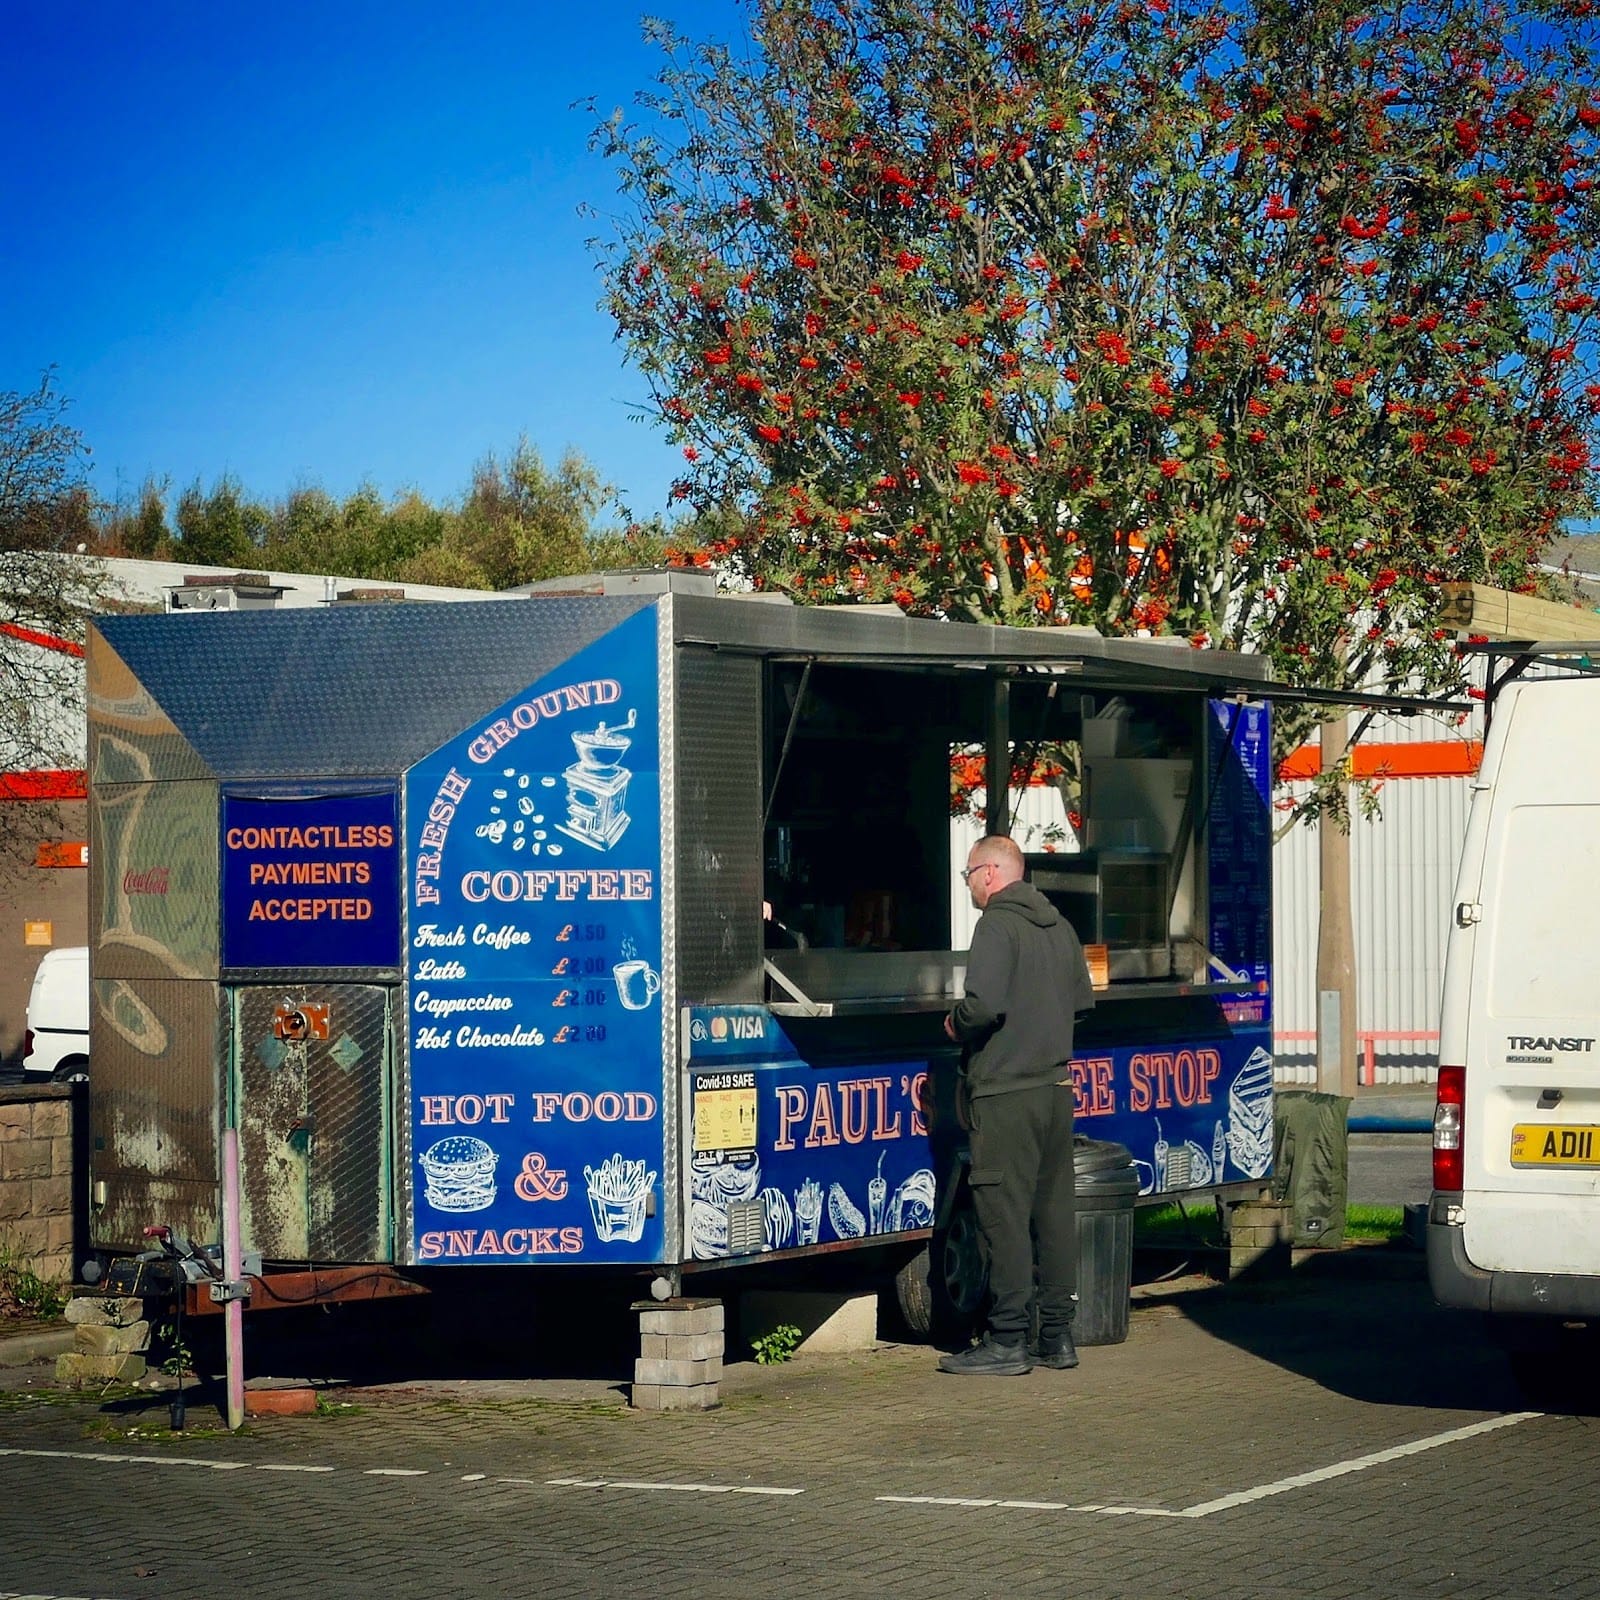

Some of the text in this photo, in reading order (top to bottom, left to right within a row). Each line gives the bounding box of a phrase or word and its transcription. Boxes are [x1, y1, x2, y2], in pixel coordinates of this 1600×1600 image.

[415, 678, 622, 908] FRESH GROUND
[226, 825, 394, 850] CONTACTLESS
[249, 862, 371, 885] PAYMENTS
[460, 869, 653, 903] COFFEE
[248, 898, 373, 922] ACCEPTED
[413, 924, 467, 948] Fresh
[472, 923, 532, 950] Coffee
[413, 958, 467, 981] Latte
[413, 990, 514, 1019] Cappuccino
[414, 1026, 452, 1050] Hot
[456, 1023, 546, 1049] Chocolate
[729, 1016, 764, 1040] VISA
[1507, 1036, 1596, 1052] TRANSIT
[696, 1073, 755, 1090] Covid-19 SAFE
[420, 1091, 657, 1126] HOT FOOD
[774, 1072, 930, 1152] PAUL'S
[1129, 1049, 1221, 1113] STOP
[1542, 1130, 1593, 1158] AD11
[514, 1152, 569, 1202] &
[419, 1226, 584, 1260] SNACKS
